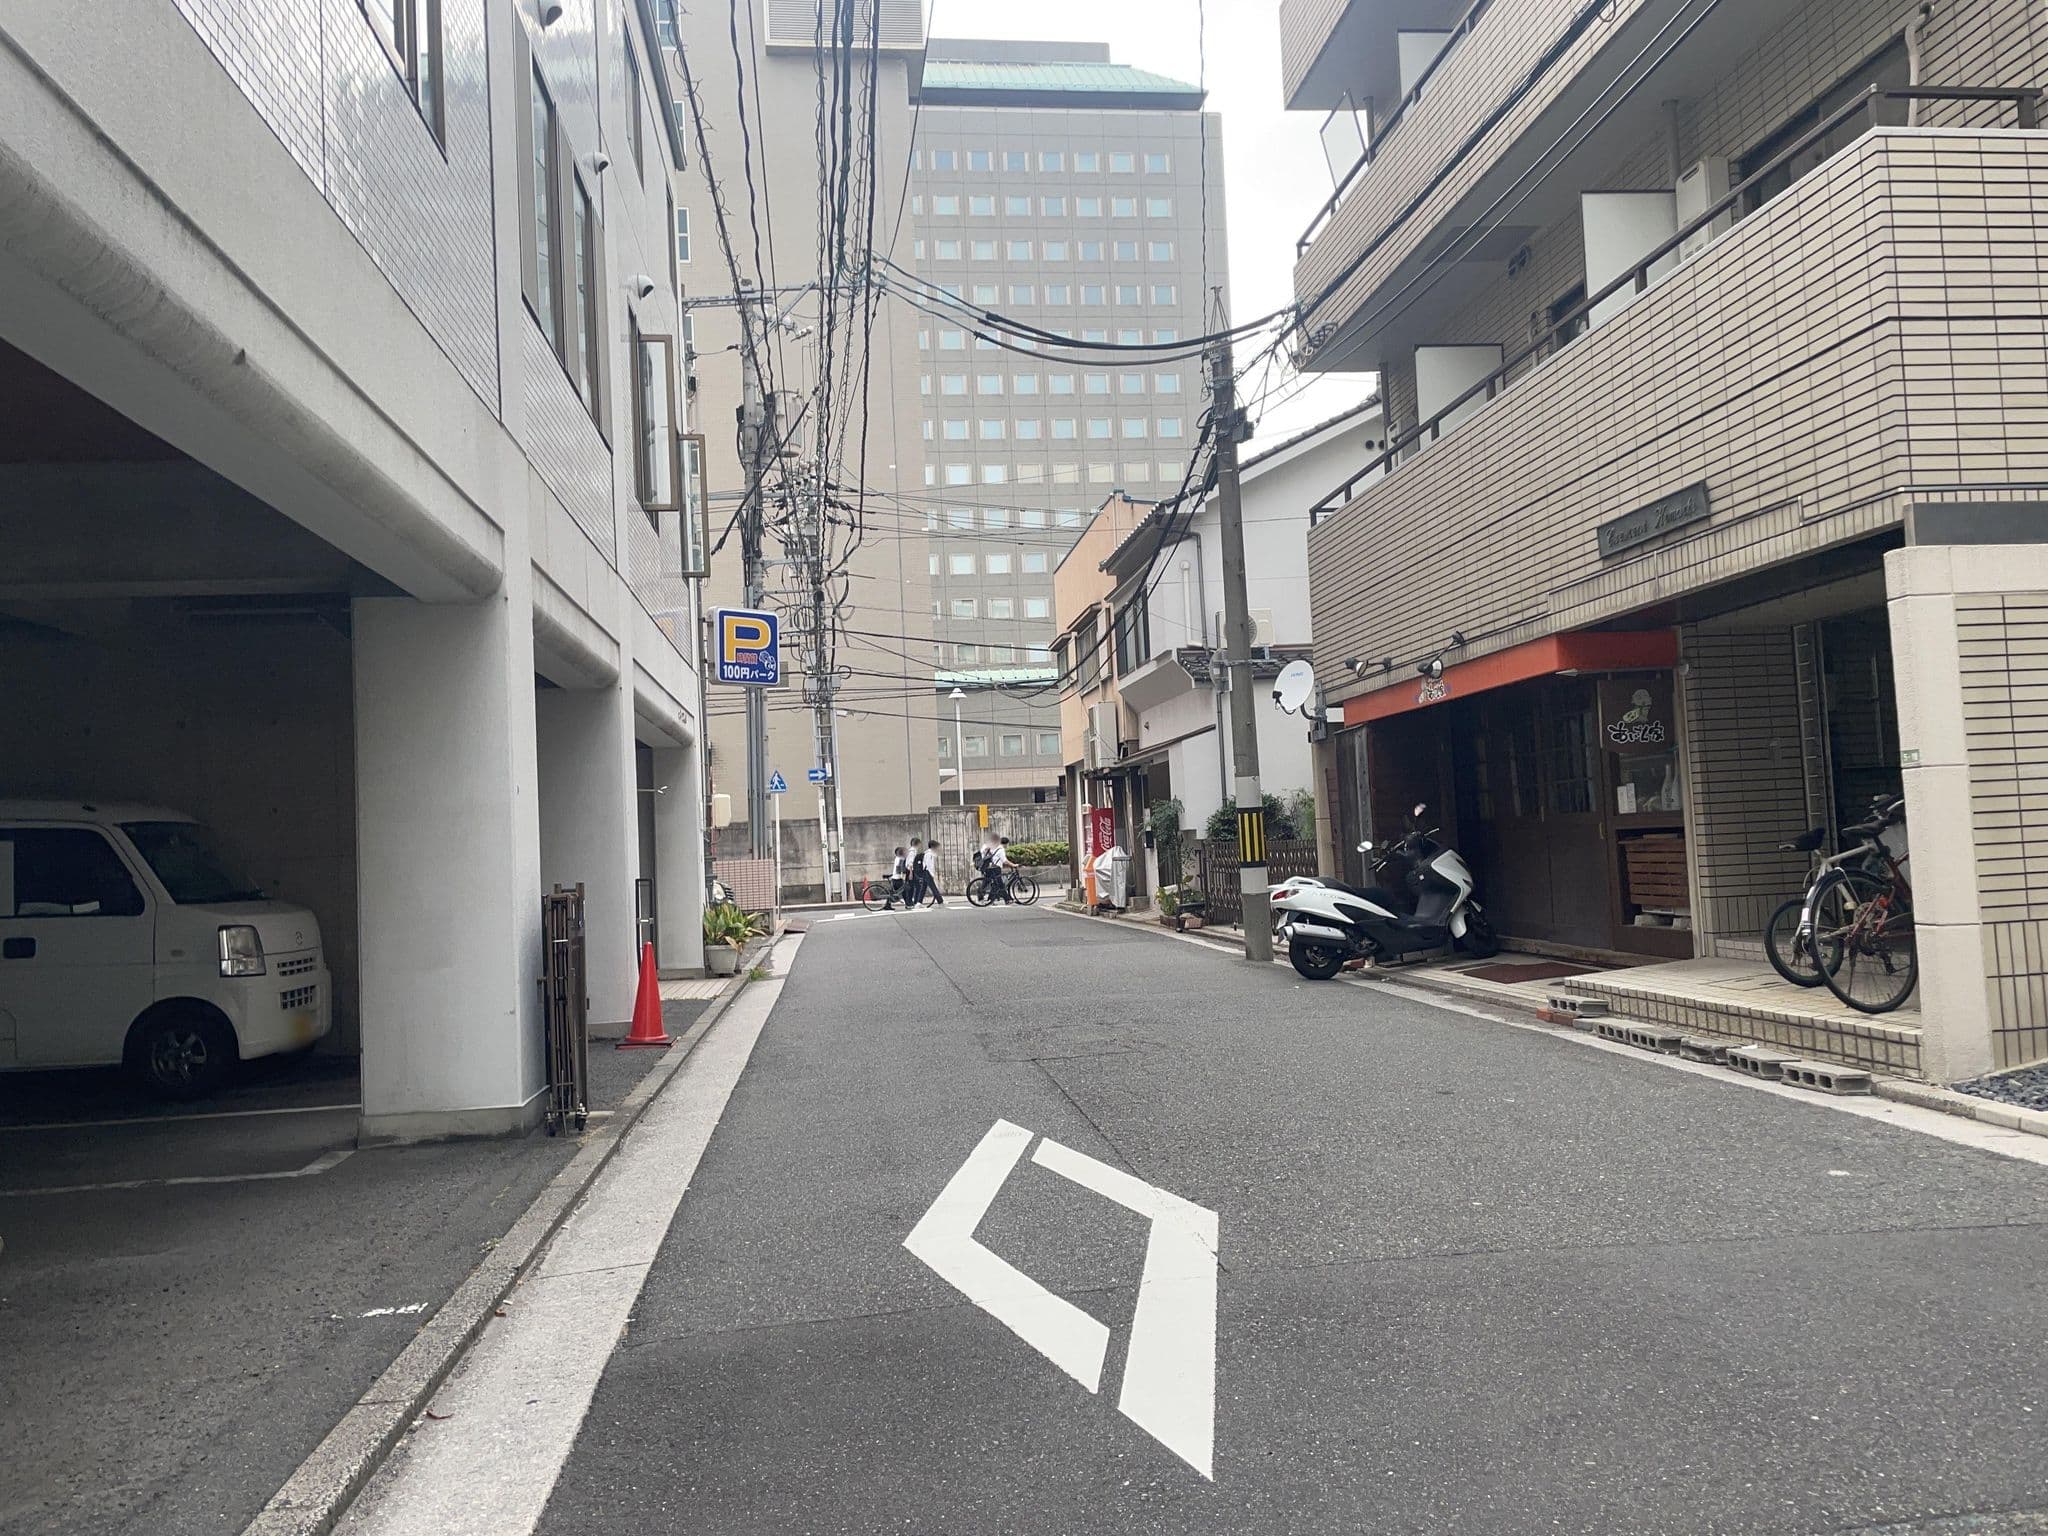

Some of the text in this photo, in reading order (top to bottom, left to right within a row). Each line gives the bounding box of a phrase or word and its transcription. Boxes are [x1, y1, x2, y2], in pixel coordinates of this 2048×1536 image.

[723, 615, 772, 663] P
[722, 664, 775, 681] 100円パーク
